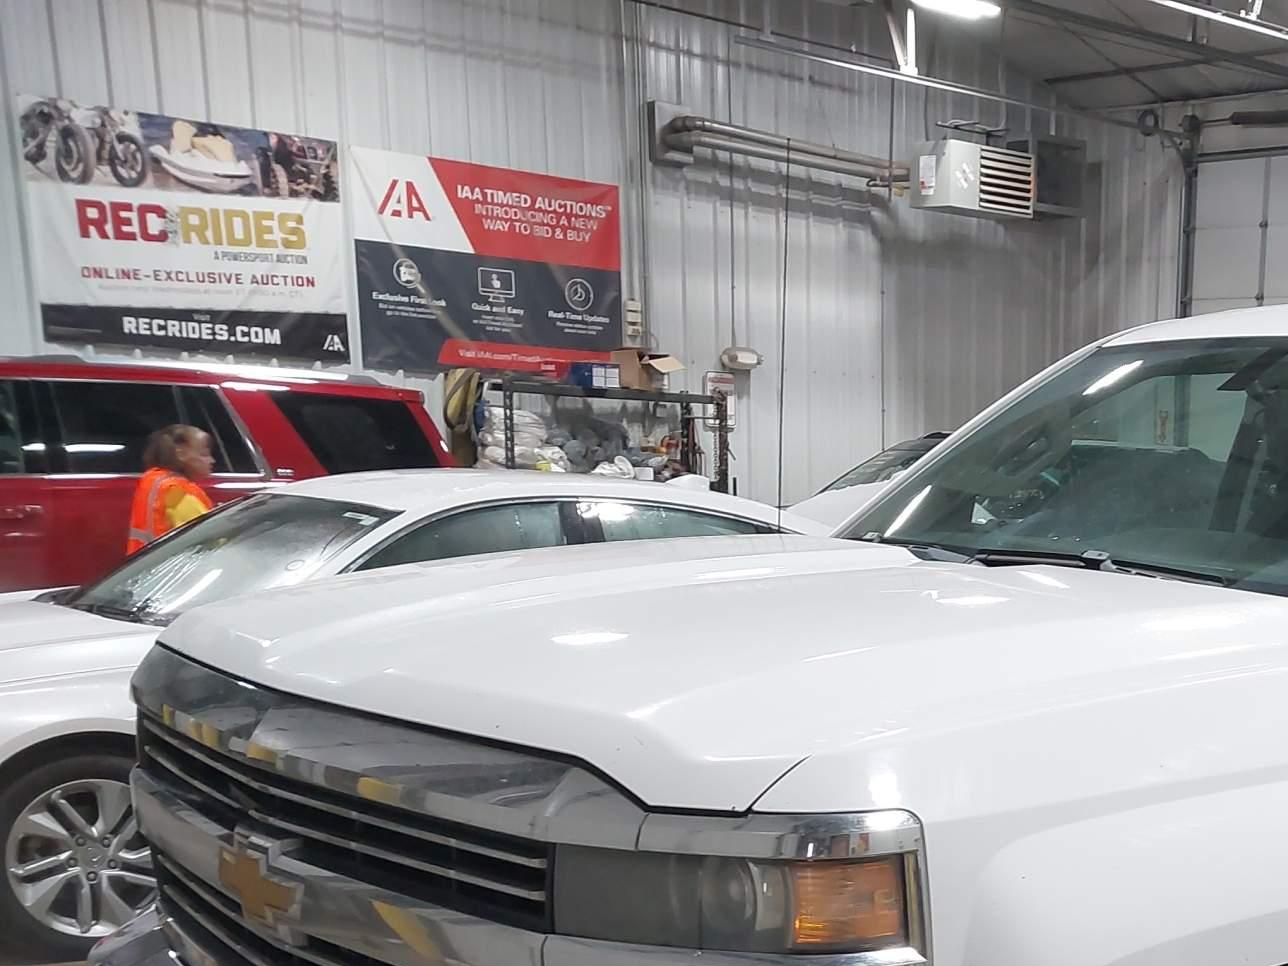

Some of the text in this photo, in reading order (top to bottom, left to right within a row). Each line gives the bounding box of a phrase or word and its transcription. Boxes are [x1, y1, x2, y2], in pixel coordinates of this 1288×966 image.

[457, 185, 483, 201] IAA
[484, 188, 531, 208] TIMED
[178, 206, 307, 250] RIDES
[474, 204, 598, 231] INTRODUCING A NEW
[482, 218, 592, 243] WAY TO BID & BUY
[214, 250, 220, 261] A
[276, 254, 308, 265] AUCTION
[81, 266, 244, 285] ONLINE-EXCLUSIVE
[250, 273, 316, 288] AUCTION
[472, 302, 491, 312] Quick
[507, 306, 524, 316] Easy
[583, 314, 610, 323] Updates
[122, 316, 282, 345] RECRIDES.COM
